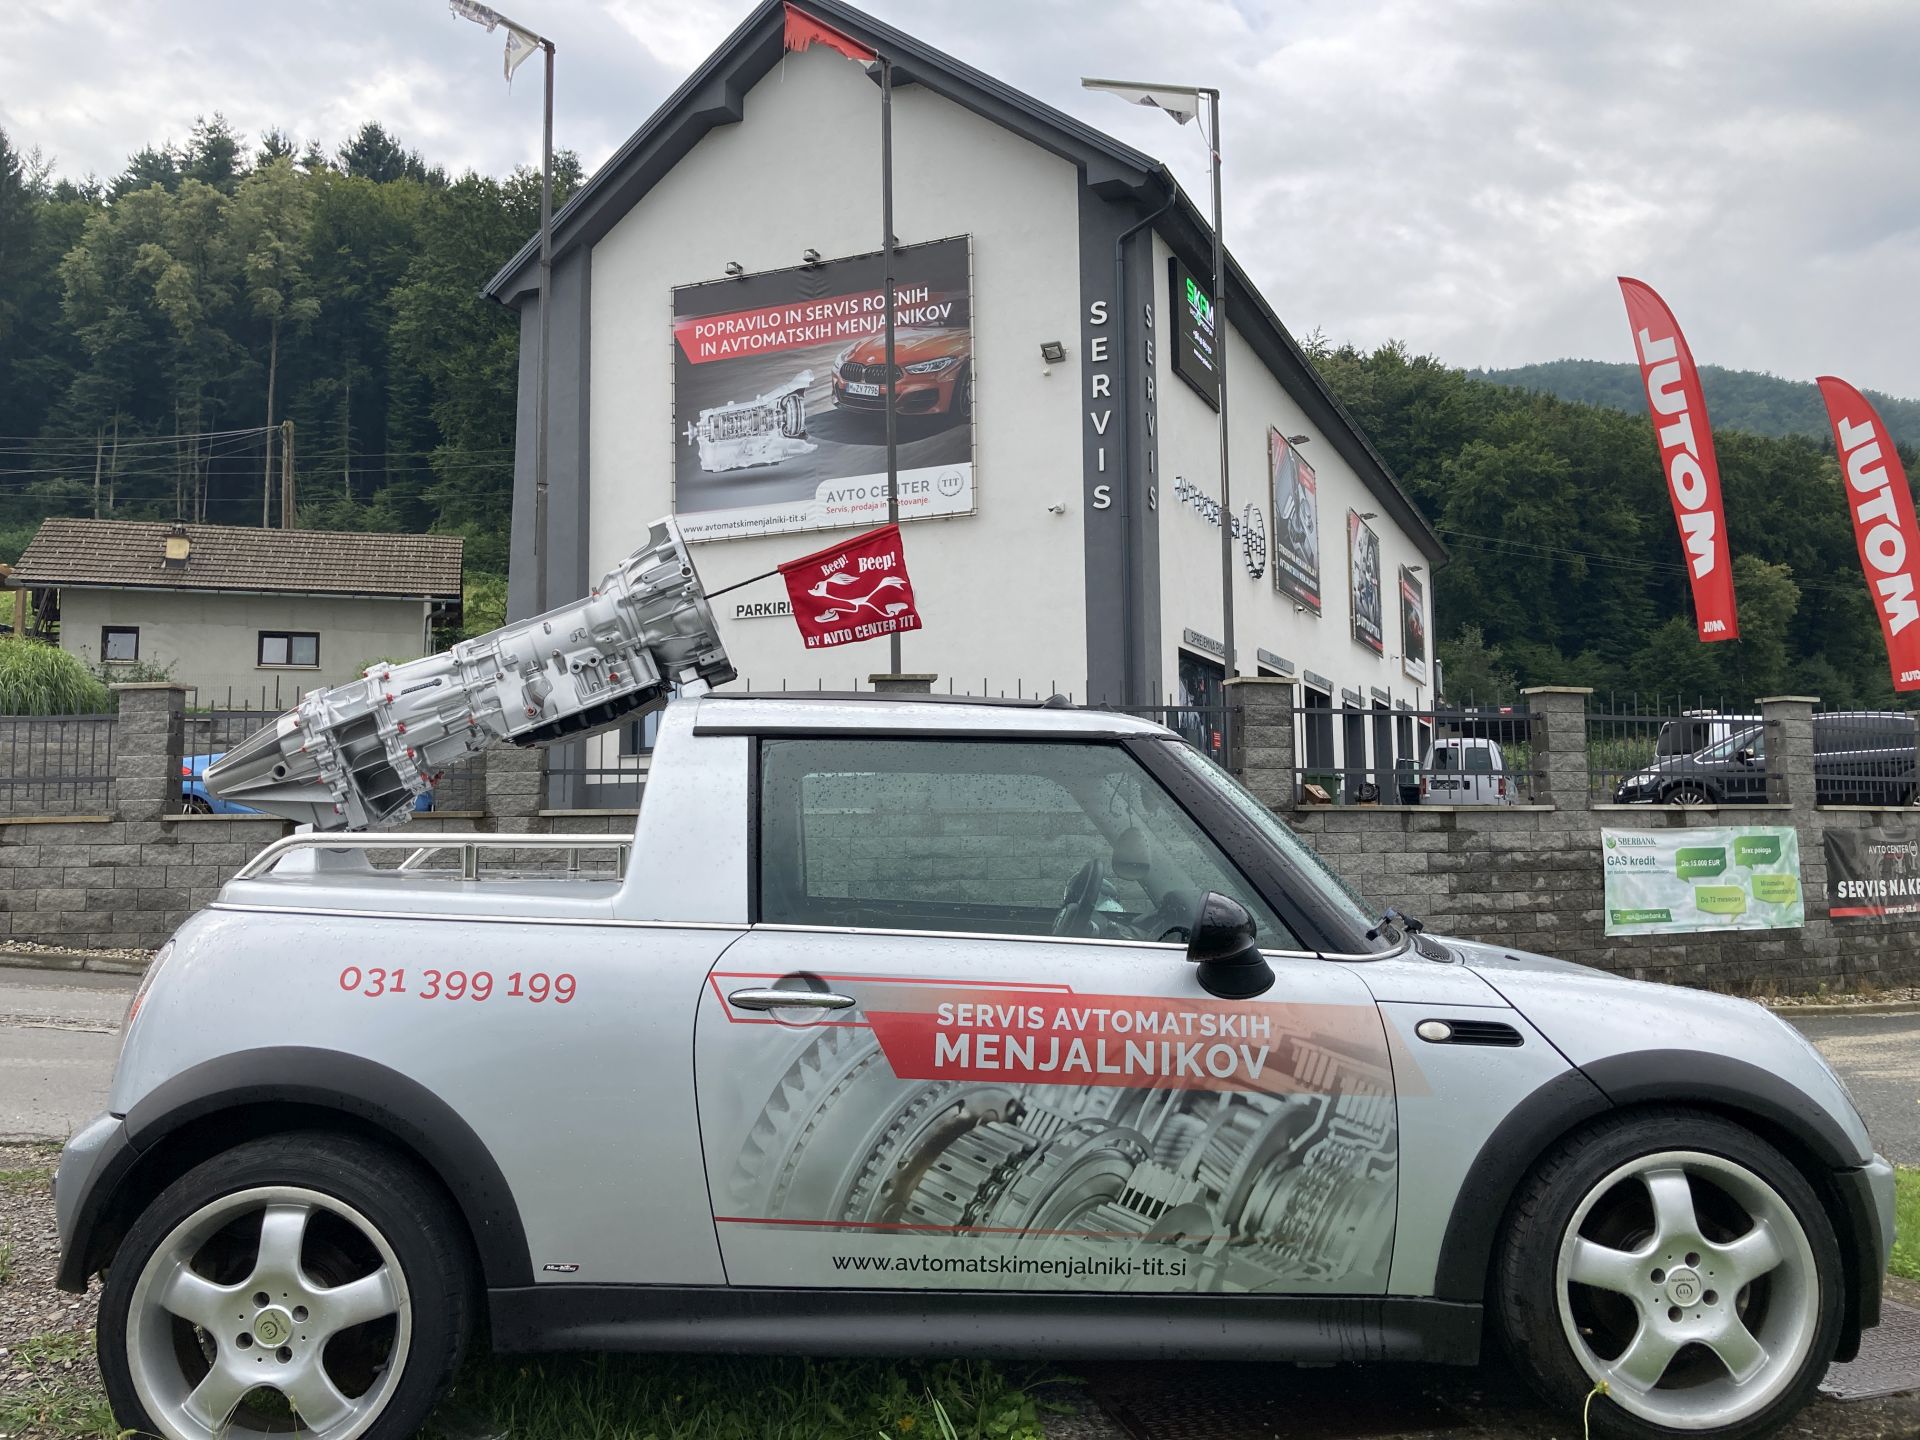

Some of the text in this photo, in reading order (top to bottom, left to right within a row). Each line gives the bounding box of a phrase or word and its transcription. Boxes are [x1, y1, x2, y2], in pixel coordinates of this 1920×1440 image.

[695, 312, 781, 339] POPRAVILO
[785, 308, 801, 325] IN
[806, 299, 859, 321] SERVIS
[701, 302, 952, 357] IN AVTOMATSKIH MENJANIKOV
[1089, 300, 1112, 509] SERVIS
[1144, 303, 1157, 511] SERVIS
[1638, 327, 1715, 580] JUTOM
[826, 480, 930, 503] AVTO CETER
[941, 477, 960, 488] TIT
[826, 506, 850, 514] Servis,
[851, 503, 879, 513] prodaja
[683, 513, 807, 534] www.avtomatskimenjalniki-tit.si
[1837, 416, 1920, 636] JUTOM
[821, 551, 896, 577] Beep! Beep!
[736, 601, 794, 617] PARKIRI
[808, 614, 915, 647] BY AVTO CENTER TIT
[1618, 837, 1656, 846] SBERBANK
[1868, 845, 1886, 854] AVTO
[1887, 844, 1908, 854] CENTER
[1607, 855, 1656, 866] GAS kredit
[1838, 880, 1887, 898] SERVIS
[1889, 879, 1907, 896] NA
[339, 966, 577, 1004] 031 399 199
[936, 1002, 1271, 1039] SERVIS AVTOMATSKIH
[934, 1032, 1270, 1080] MENJALNIKOV
[832, 1254, 1186, 1277] www.avtomatskimenjalniki-tit.si
